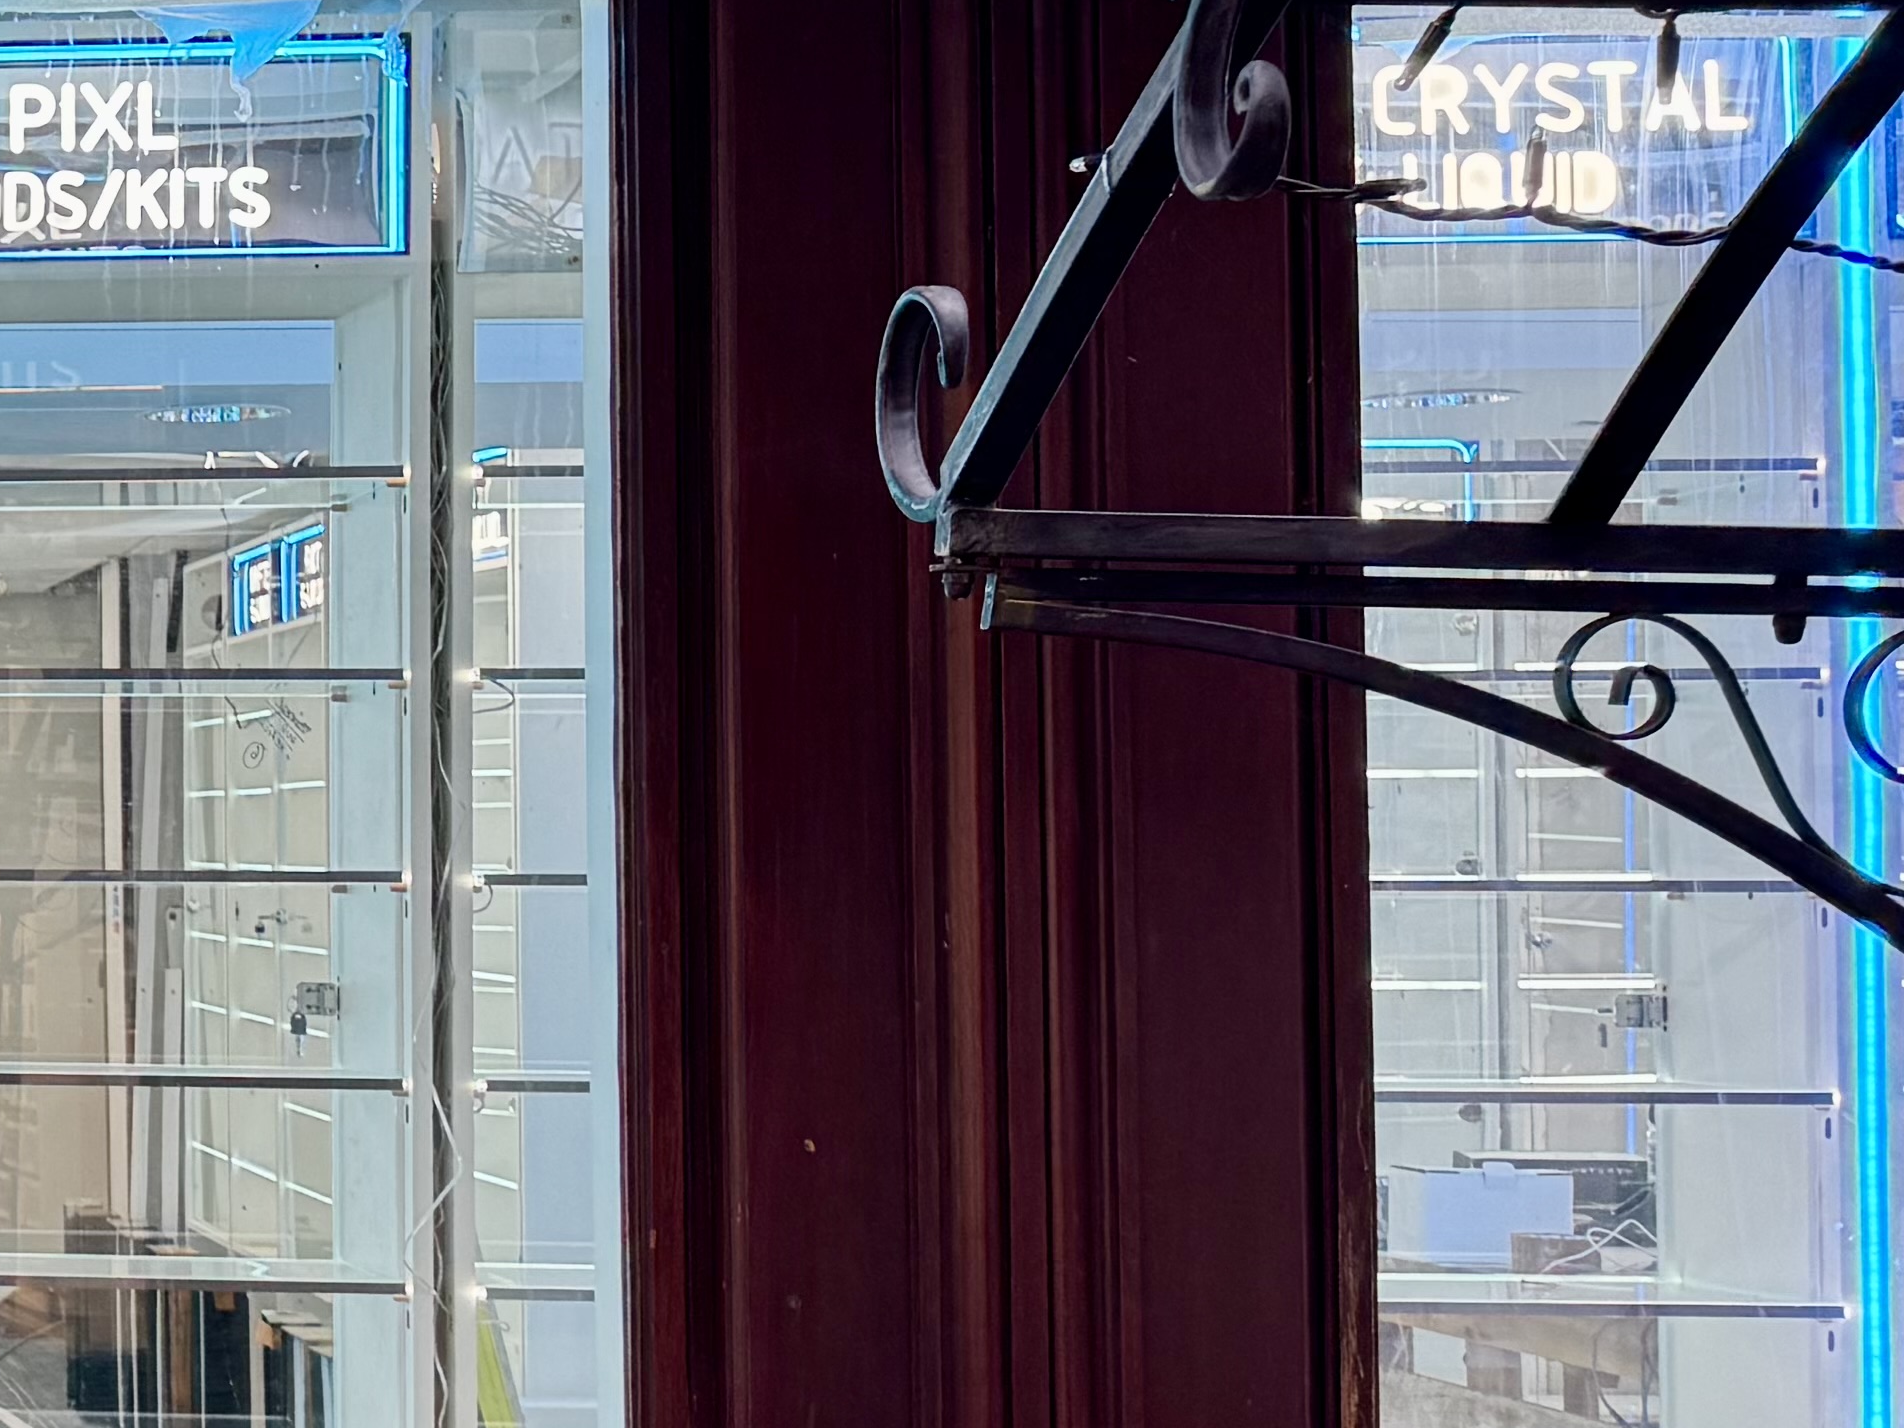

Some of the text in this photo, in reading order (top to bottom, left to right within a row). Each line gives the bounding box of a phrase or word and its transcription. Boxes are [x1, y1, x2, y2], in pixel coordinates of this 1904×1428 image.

[8, 80, 180, 155] PIXL
[1371, 58, 1749, 137] CRYSTAL
[1356, 149, 1618, 214] LIQUID
